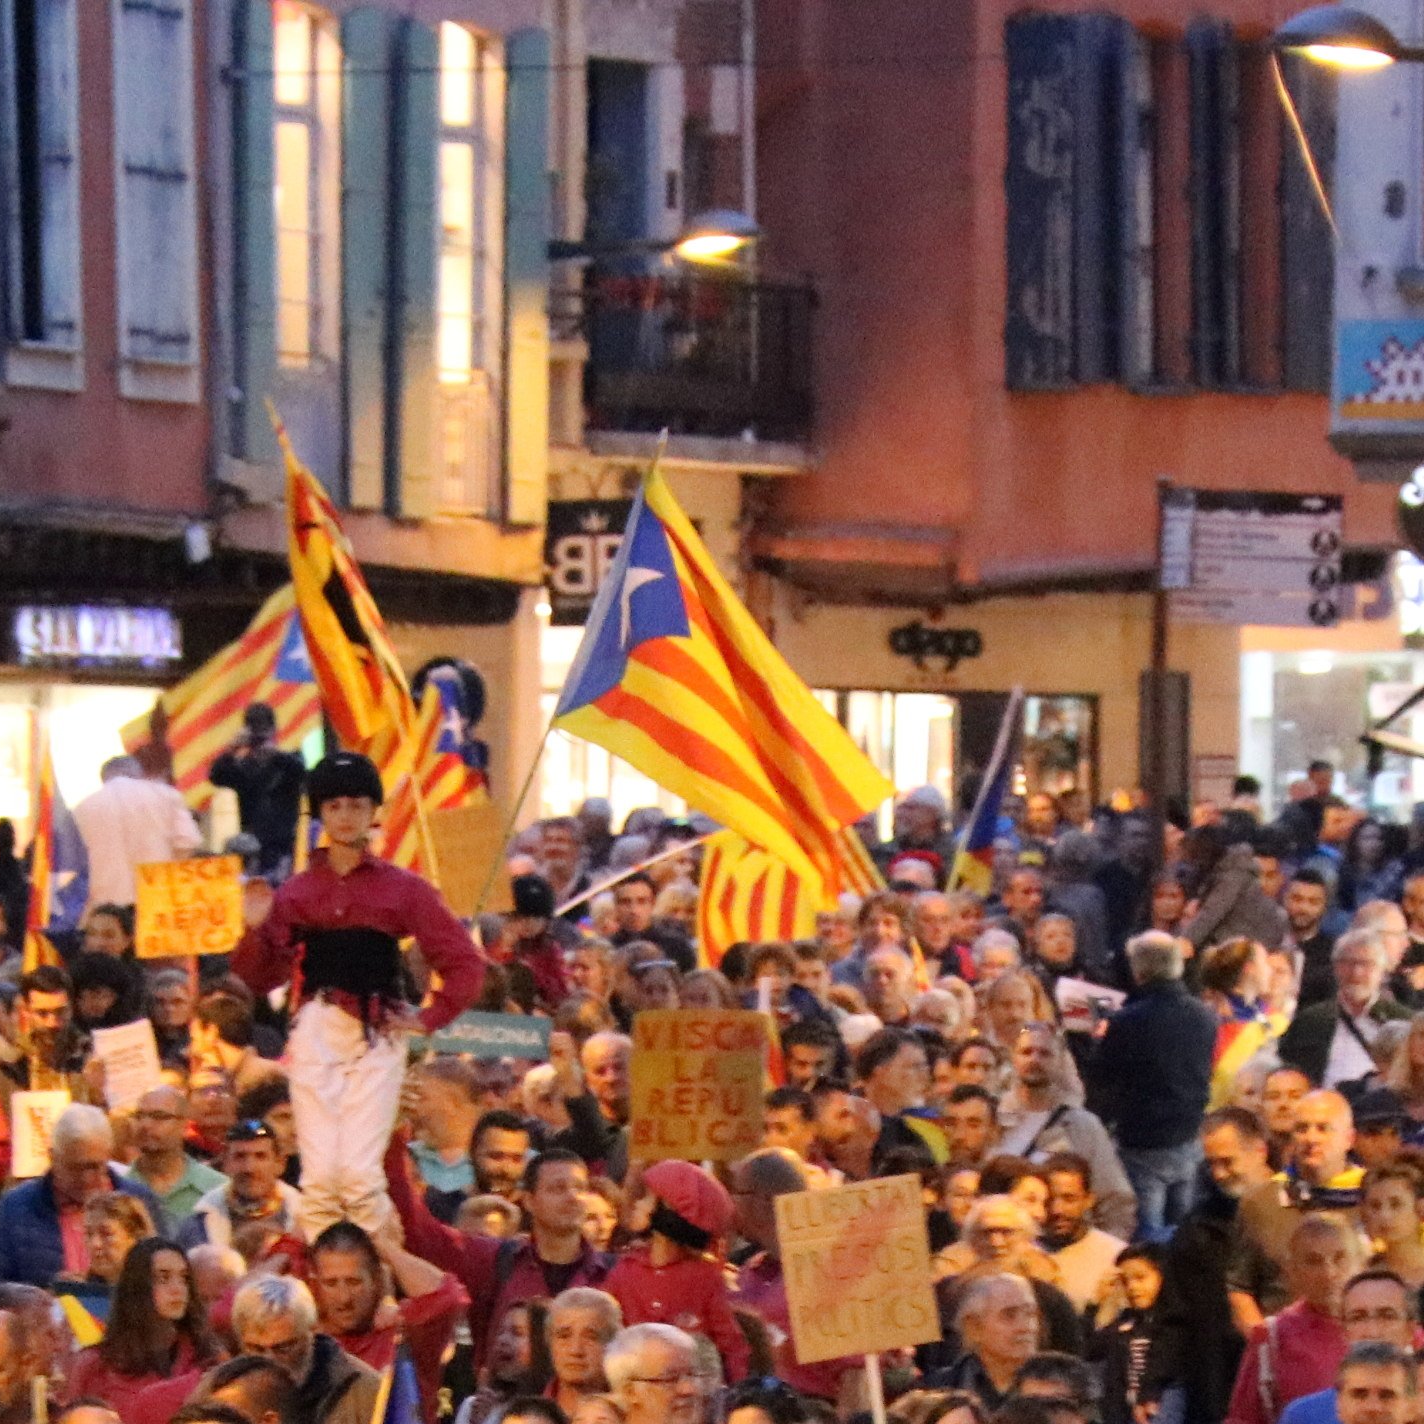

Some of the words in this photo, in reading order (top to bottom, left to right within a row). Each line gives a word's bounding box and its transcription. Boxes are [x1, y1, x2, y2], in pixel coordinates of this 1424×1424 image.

[638, 1019, 764, 1051] VISCA
[673, 1056, 719, 1084] LA
[632, 1119, 758, 1147] BLICA
